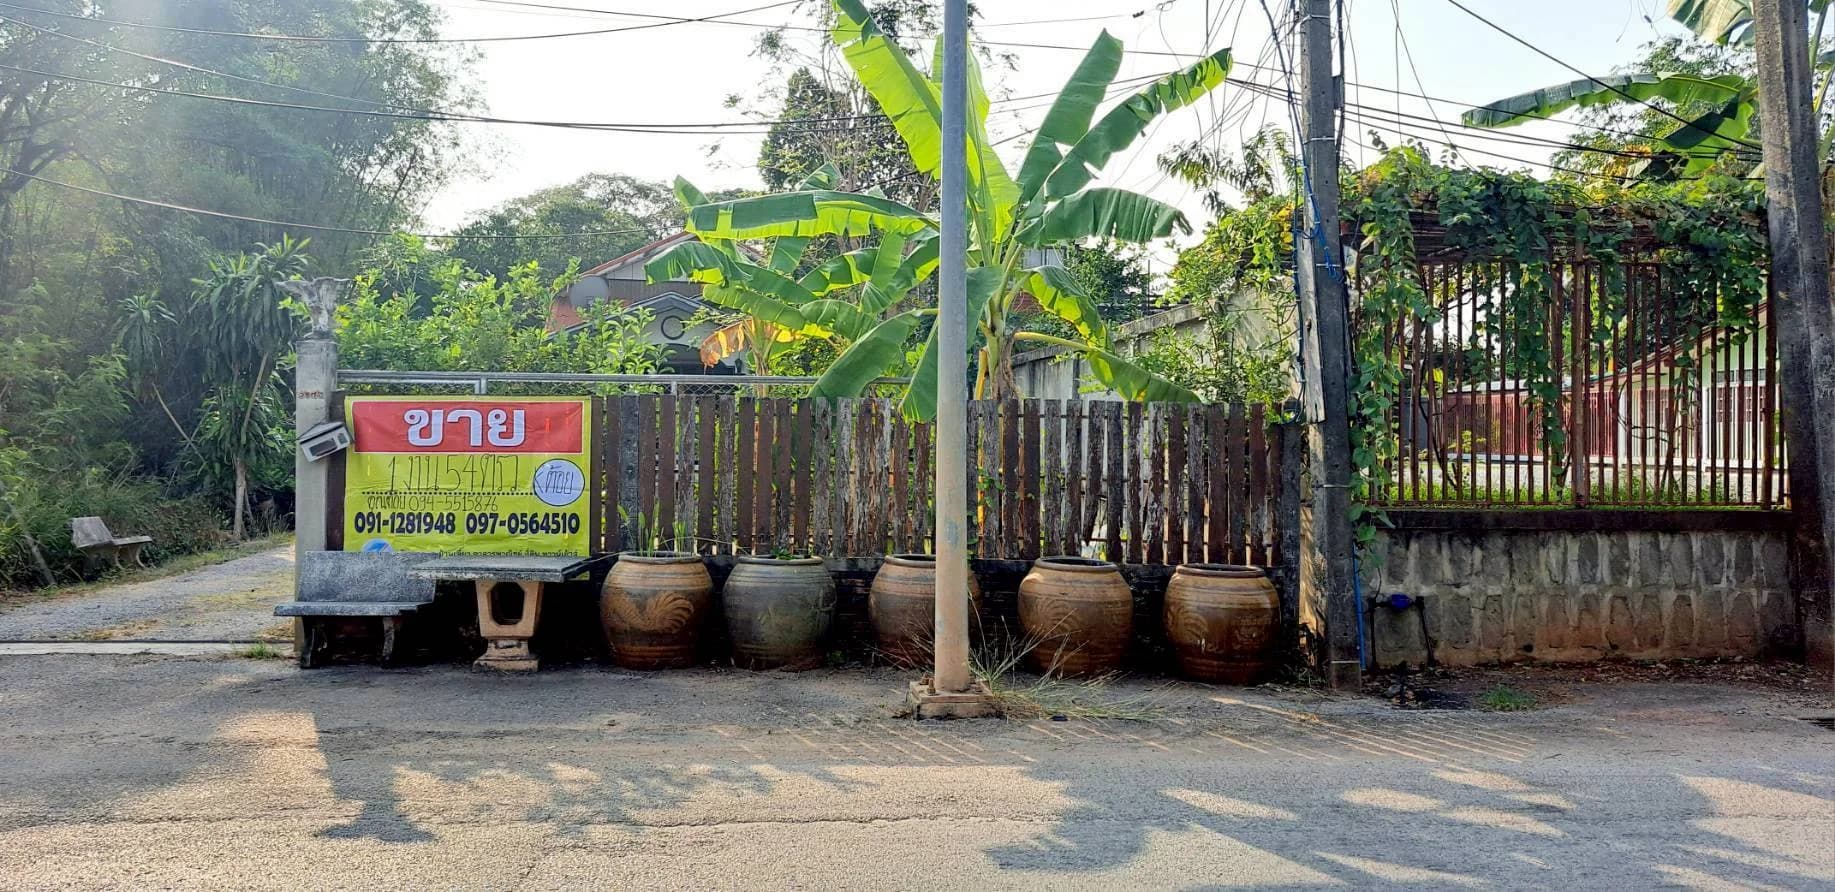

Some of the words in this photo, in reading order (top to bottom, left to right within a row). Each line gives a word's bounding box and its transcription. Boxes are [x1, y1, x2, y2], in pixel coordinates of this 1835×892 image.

[404, 408, 526, 447] ขาย
[354, 511, 456, 534] 091-1281948
[466, 512, 580, 535] 097-0564510
